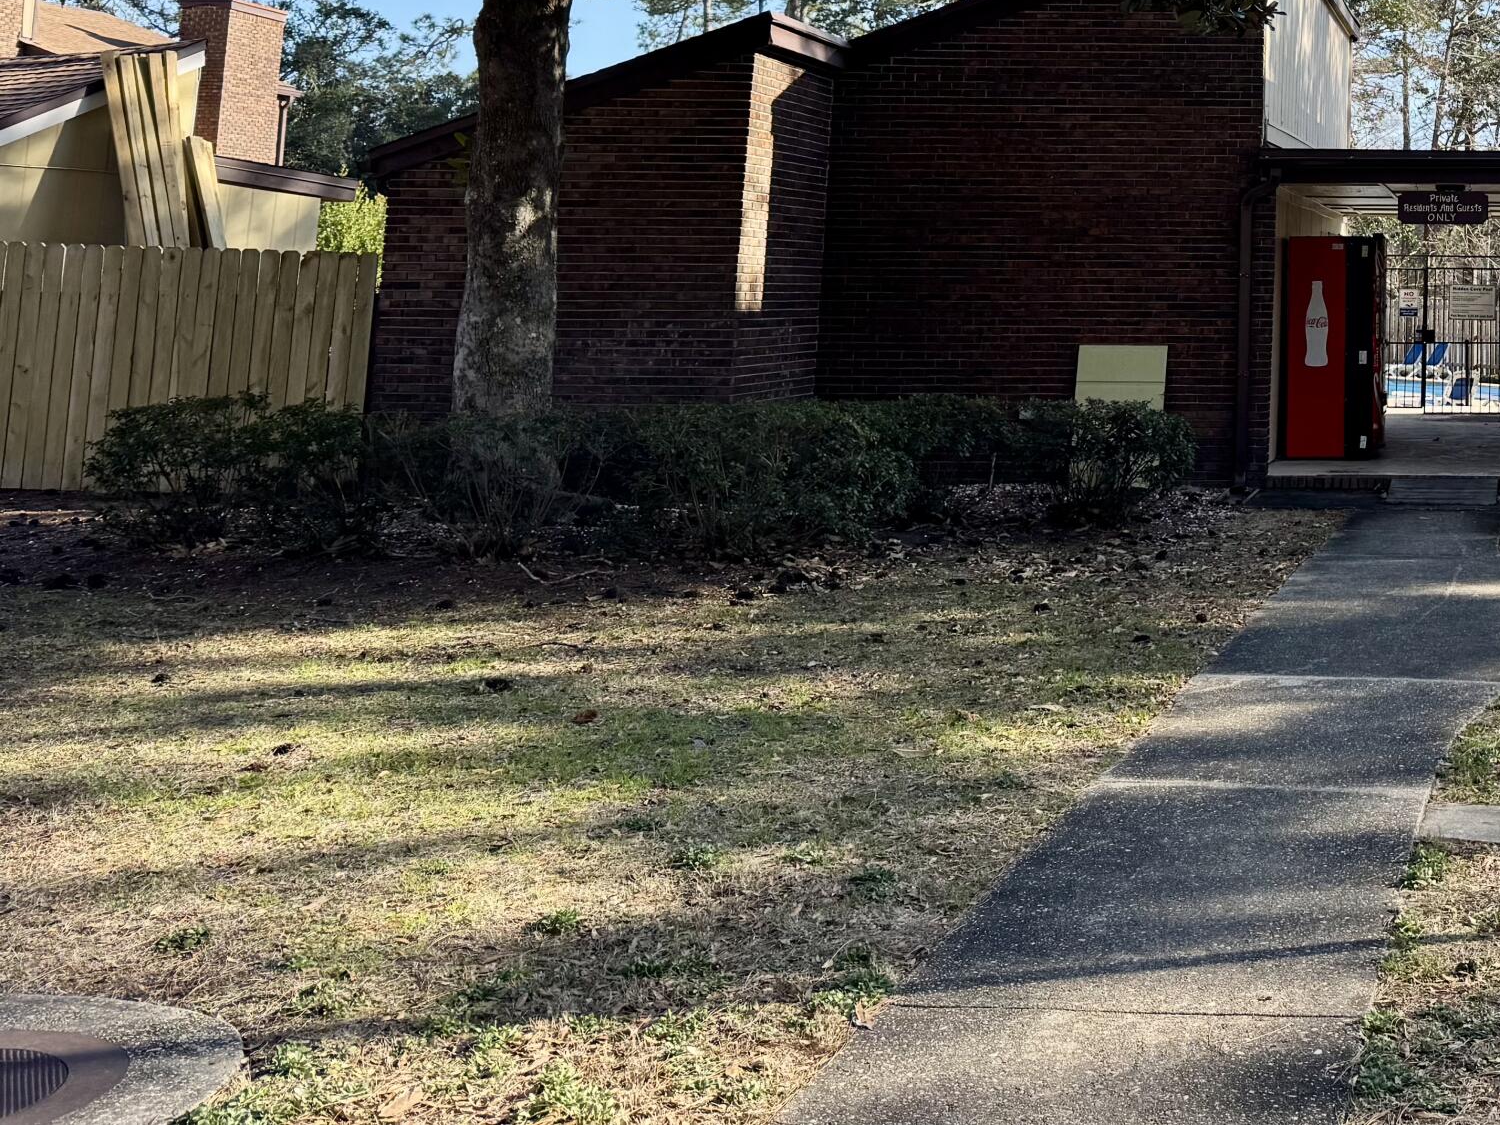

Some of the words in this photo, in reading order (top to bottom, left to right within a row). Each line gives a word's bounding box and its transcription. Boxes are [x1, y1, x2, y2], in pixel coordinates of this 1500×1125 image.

[1429, 193, 1459, 203] Private
[1403, 203, 1438, 212] Residents
[1439, 203, 1454, 212] And
[1456, 203, 1482, 212] Guests
[1427, 213, 1457, 222] ONLY
